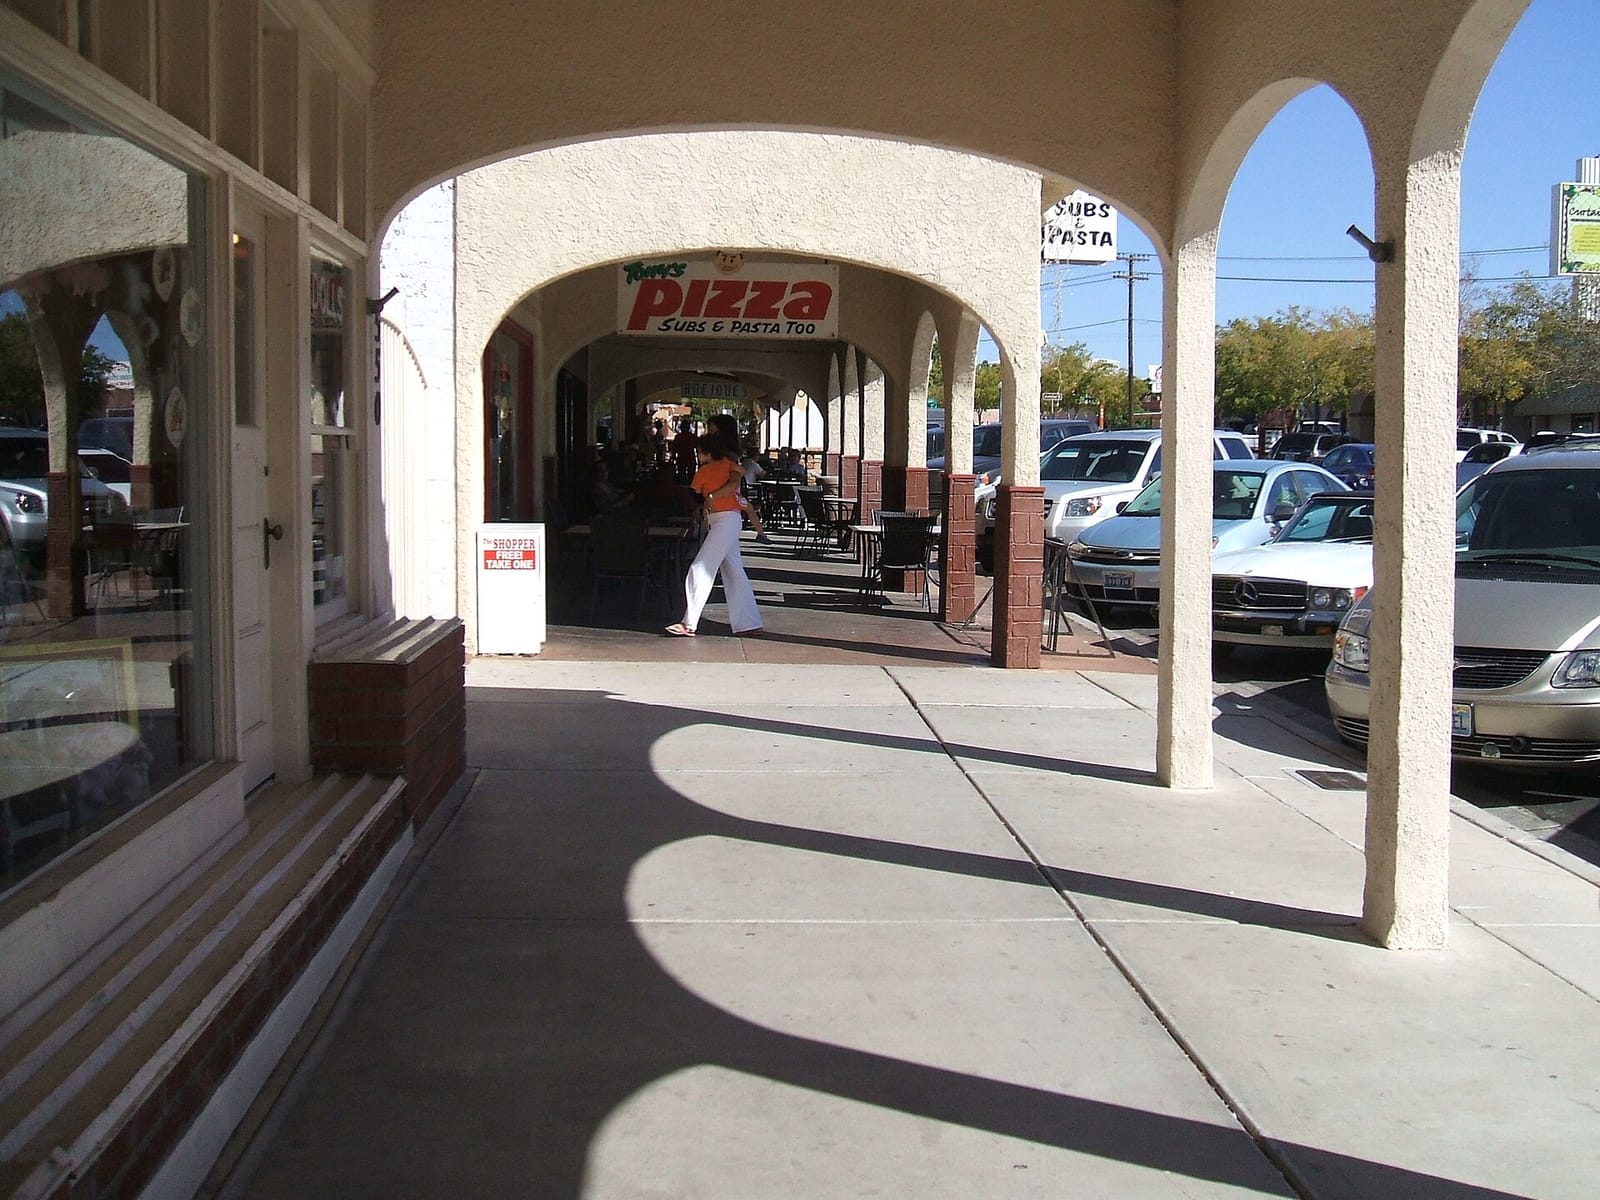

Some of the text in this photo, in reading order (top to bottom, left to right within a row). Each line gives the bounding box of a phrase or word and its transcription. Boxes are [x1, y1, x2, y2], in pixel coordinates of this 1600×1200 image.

[1054, 200, 1111, 218] SUBS
[1048, 225, 1113, 247] PASTA
[658, 318, 707, 333] SUBS
[712, 321, 724, 333] &
[730, 320, 780, 334] PASTA
[493, 538, 536, 549] SHOPPER
[496, 551, 521, 560] FREE
[486, 559, 534, 569] TAKE ONE
